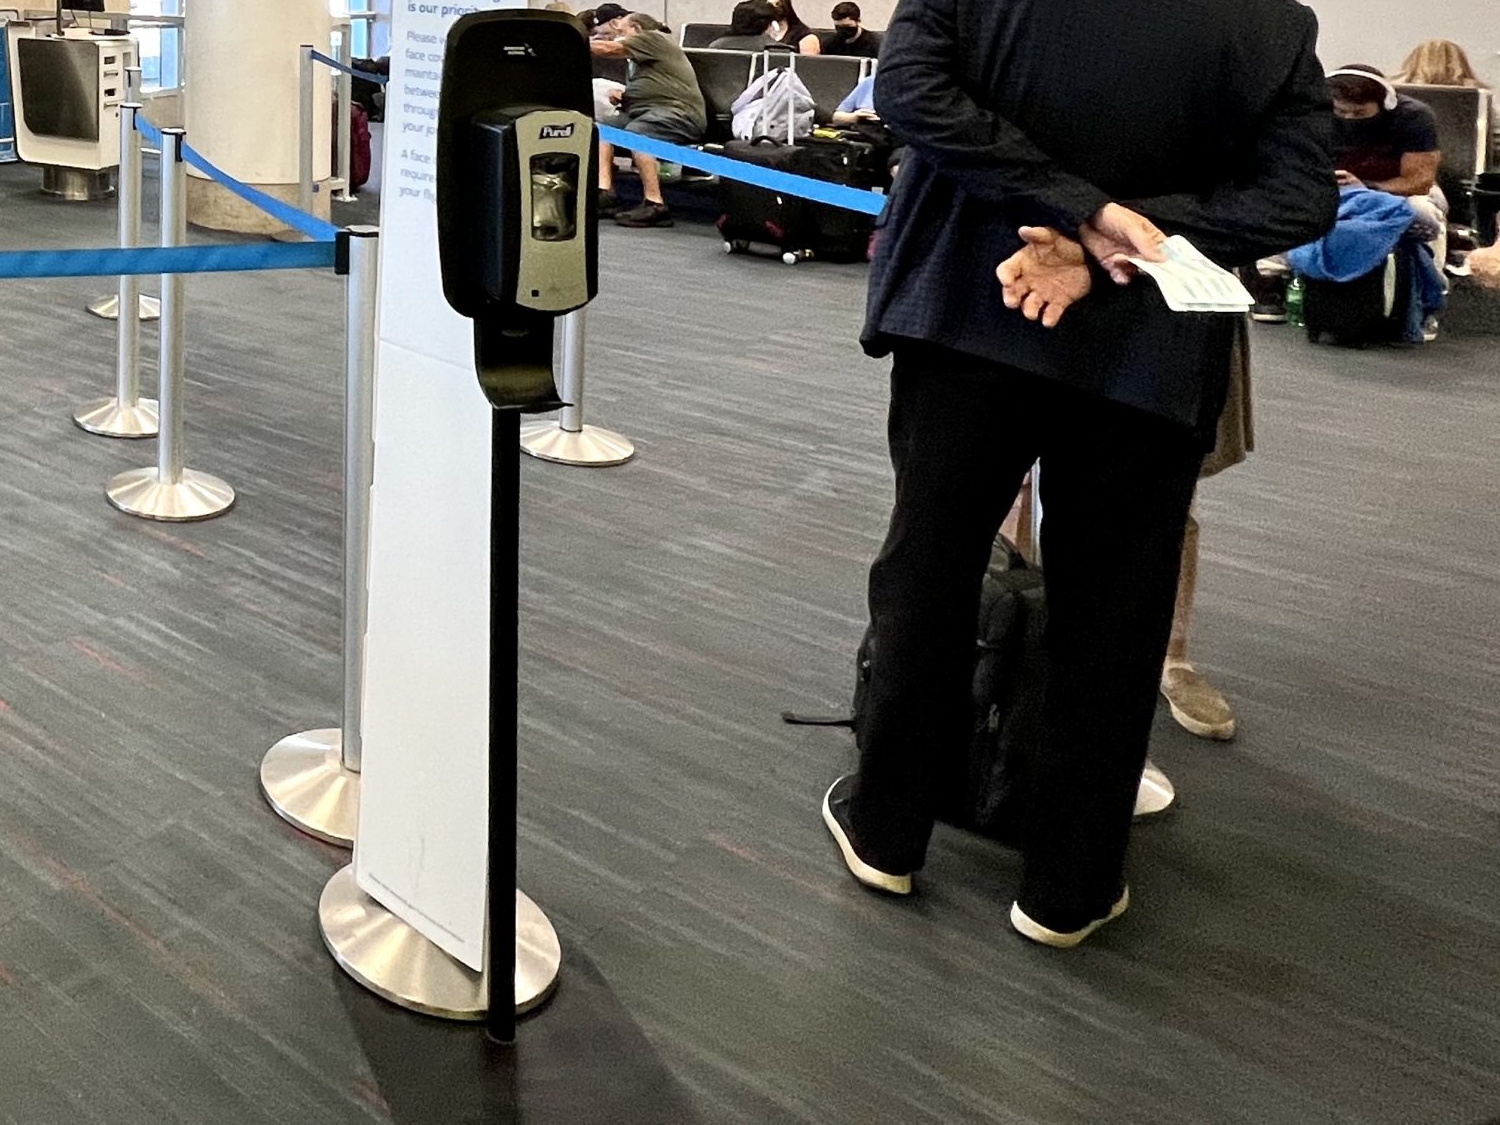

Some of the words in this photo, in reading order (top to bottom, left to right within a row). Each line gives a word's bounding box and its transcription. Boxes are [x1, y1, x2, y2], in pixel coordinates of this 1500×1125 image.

[407, 0, 416, 12] is
[418, 3, 438, 13] our
[441, 3, 479, 18] priori
[406, 30, 437, 44] Please
[405, 48, 426, 61] face
[404, 68, 438, 81] mainta
[403, 103, 436, 120] throug
[402, 121, 424, 133] your
[401, 149, 408, 159] A
[410, 149, 431, 164] face
[399, 186, 421, 197] your
